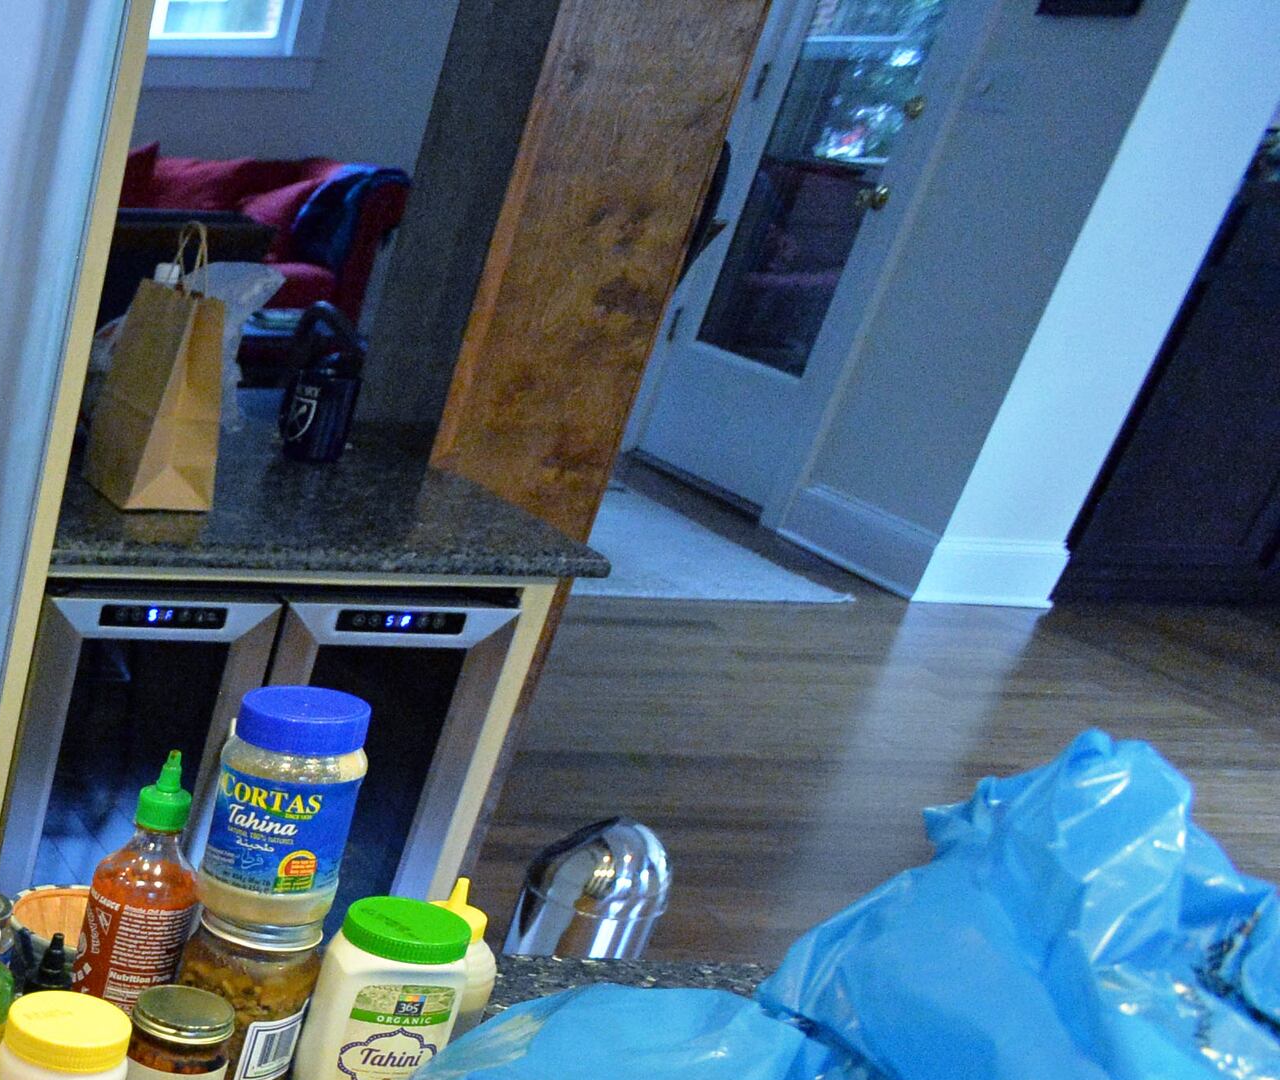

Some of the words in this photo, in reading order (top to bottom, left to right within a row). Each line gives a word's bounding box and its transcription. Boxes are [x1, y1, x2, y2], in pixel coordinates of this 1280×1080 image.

[221, 772, 323, 815] CORTAS
[229, 803, 298, 837] Tahina
[109, 971, 151, 984] Nutrition
[400, 1002, 420, 1014] 365
[376, 1015, 433, 1025] ORGANIC
[360, 1048, 424, 1068] Tahini
